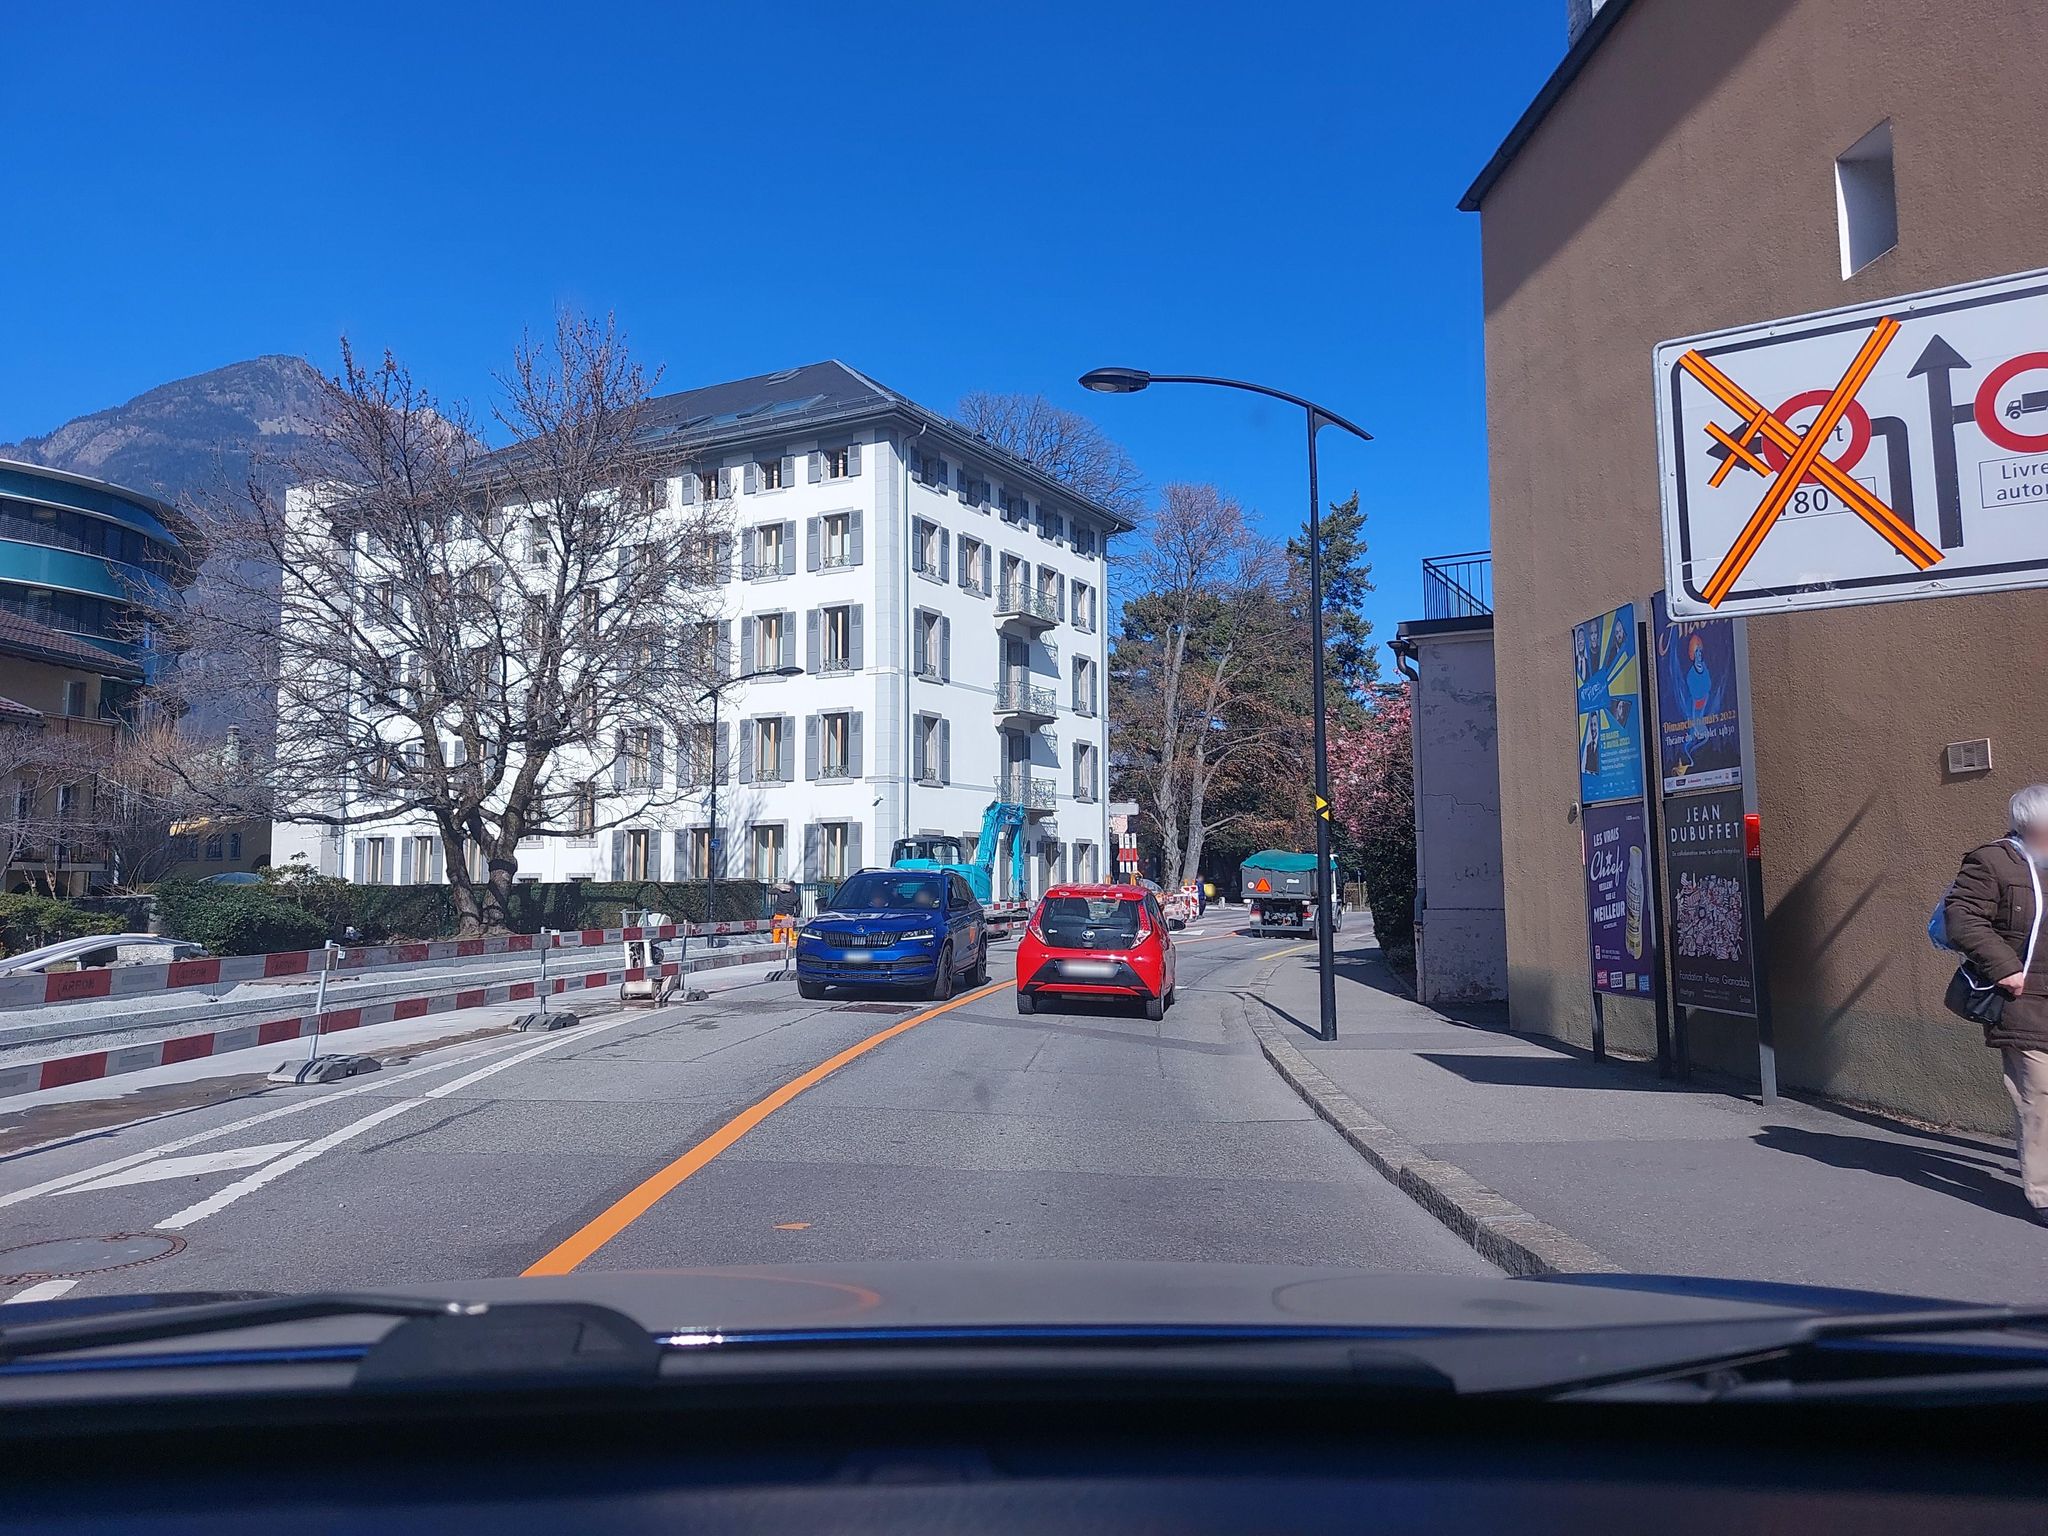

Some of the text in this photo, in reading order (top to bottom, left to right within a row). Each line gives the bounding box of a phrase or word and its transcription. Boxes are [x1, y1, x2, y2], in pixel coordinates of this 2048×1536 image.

[1720, 709, 1736, 721] 2022
[1686, 804, 1720, 823] JEAN
[1593, 827, 1620, 847] LES VRAIS
[1671, 822, 1739, 842] DUBUFFET
[1590, 845, 1623, 887] Chiefs
[1593, 900, 1626, 923] MEILLEUR
